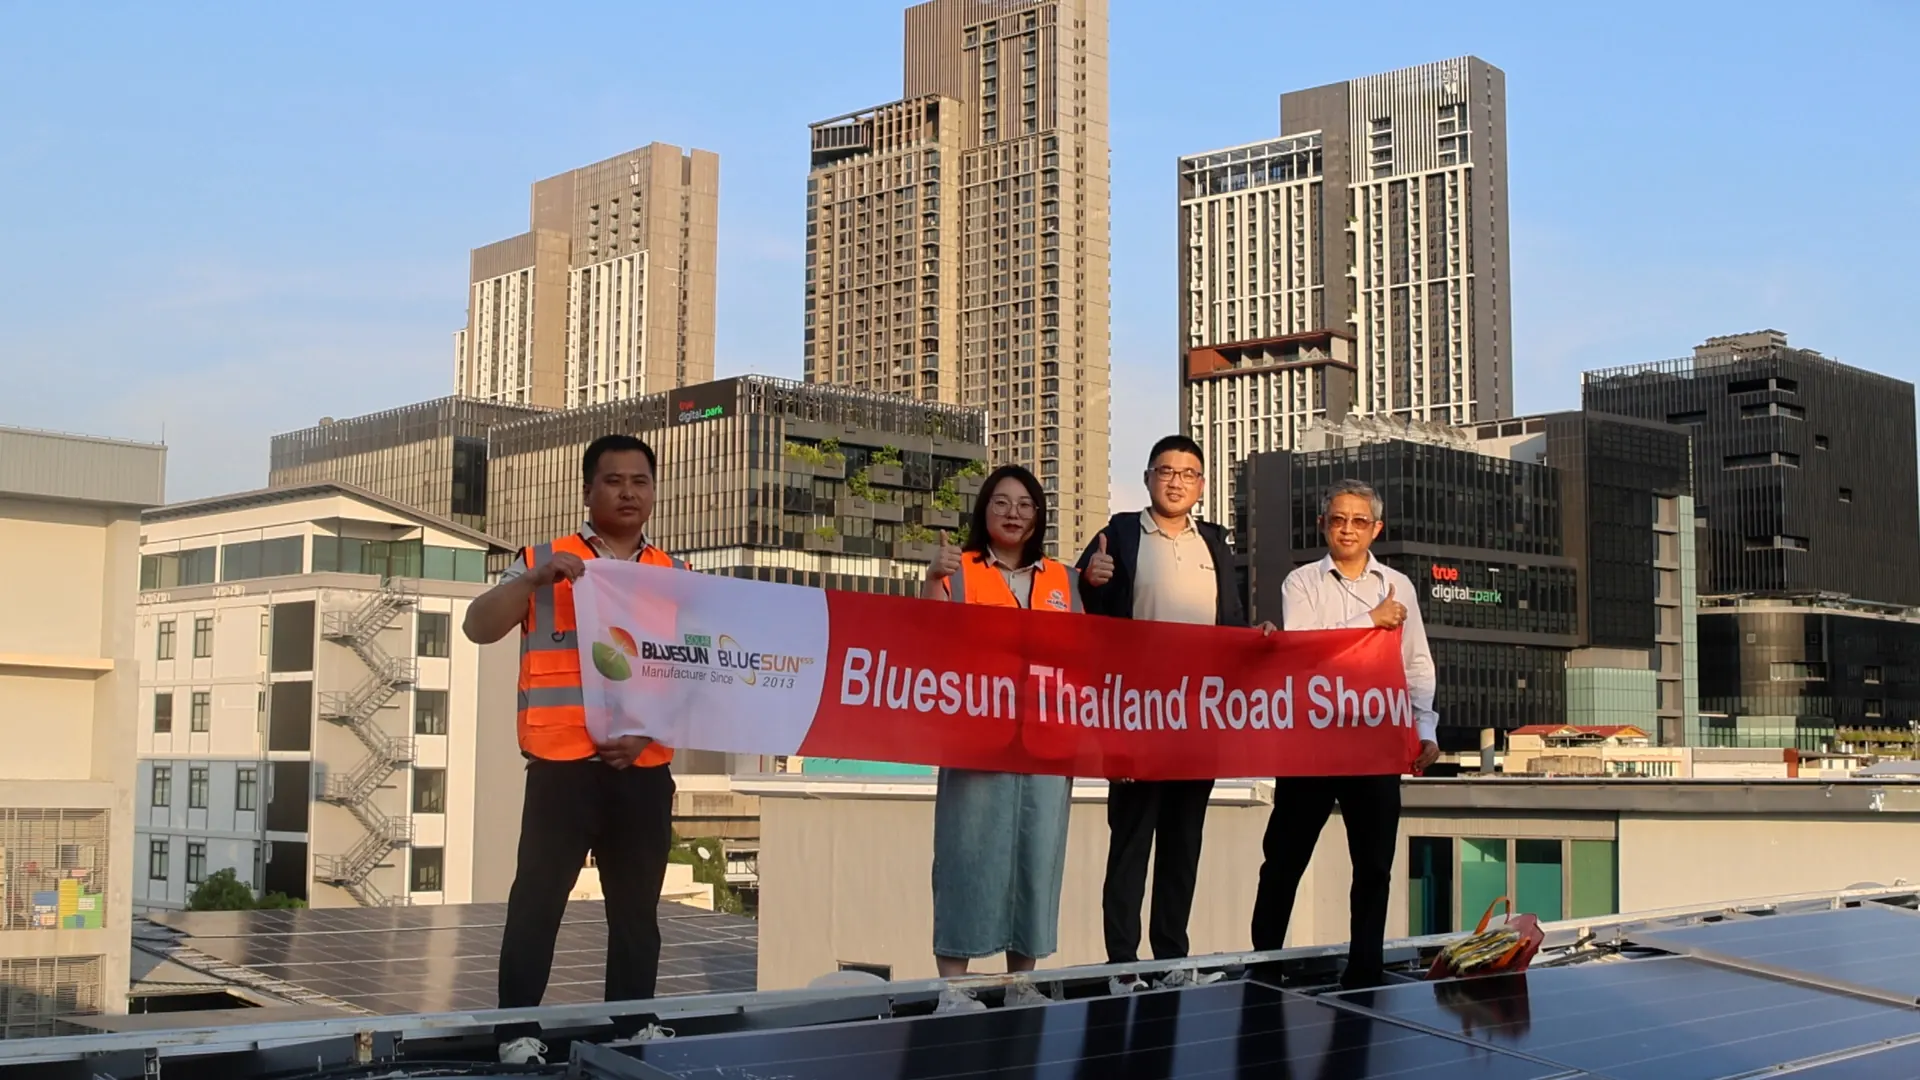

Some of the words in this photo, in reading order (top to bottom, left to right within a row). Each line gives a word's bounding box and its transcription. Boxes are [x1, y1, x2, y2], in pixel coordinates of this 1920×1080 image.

[1432, 563, 1458, 580] true
[641, 641, 709, 665] BLUESUN
[641, 665, 707, 681] Manufacturer
[710, 670, 734, 685] Since
[762, 676, 795, 689] 2013
[840, 647, 1016, 720] Bluesun
[1029, 664, 1188, 731] Thailand
[1200, 676, 1294, 730] Road
[1308, 675, 1412, 729] Show
